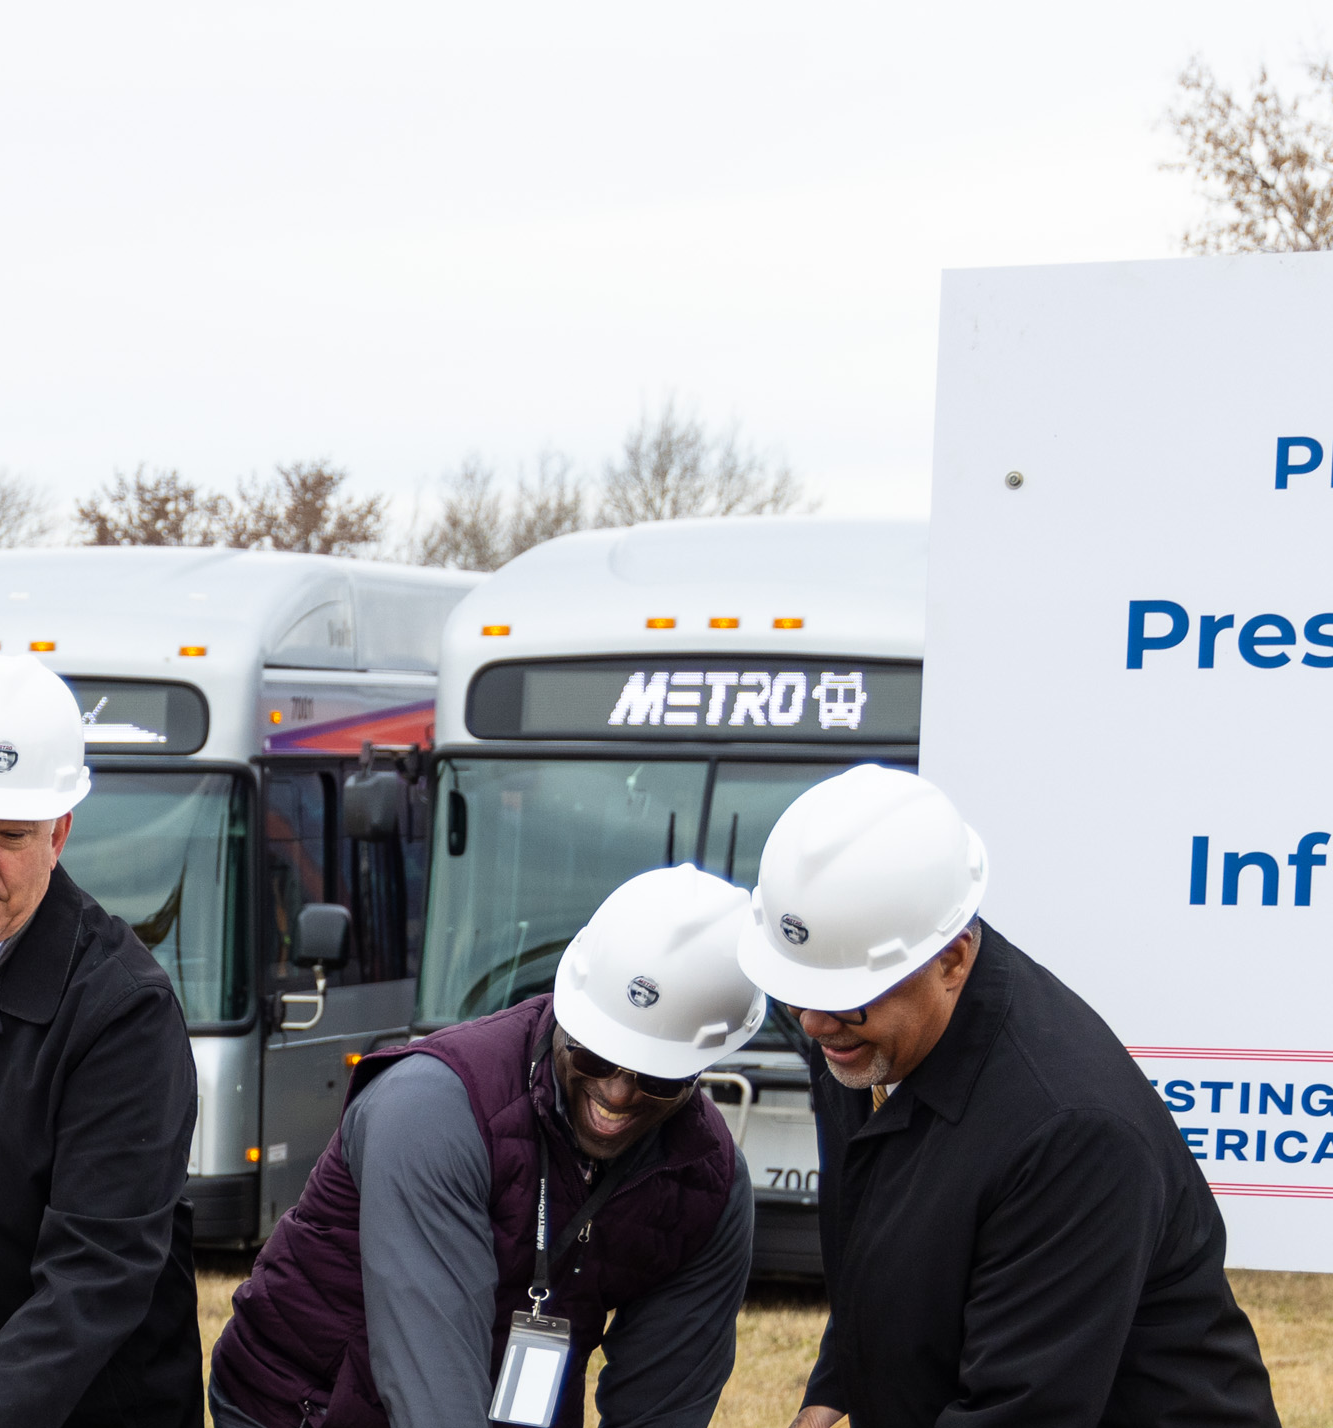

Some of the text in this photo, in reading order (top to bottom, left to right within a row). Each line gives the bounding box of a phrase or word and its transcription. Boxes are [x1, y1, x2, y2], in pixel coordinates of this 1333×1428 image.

[607, 671, 807, 726] METRO
[1189, 831, 1332, 906] Inf
[1148, 1079, 1333, 1117] STING
[536, 1178, 546, 1251] #METROproud
